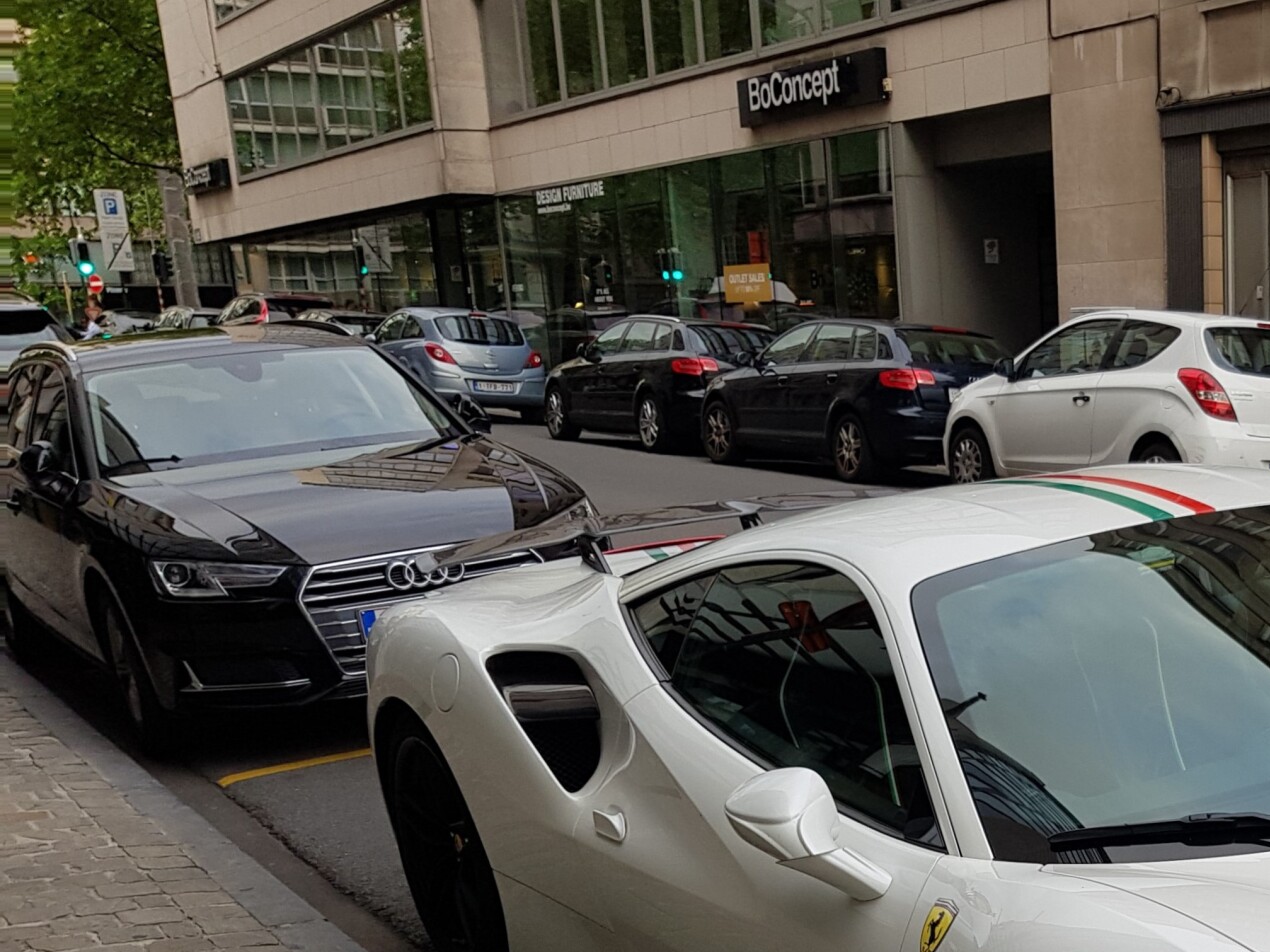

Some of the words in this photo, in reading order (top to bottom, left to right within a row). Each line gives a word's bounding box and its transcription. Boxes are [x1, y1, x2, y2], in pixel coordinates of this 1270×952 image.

[748, 59, 840, 112] BoConcept
[535, 187, 562, 205] DESIGN
[562, 180, 605, 202] FURNITURE
[104, 199, 116, 214] P
